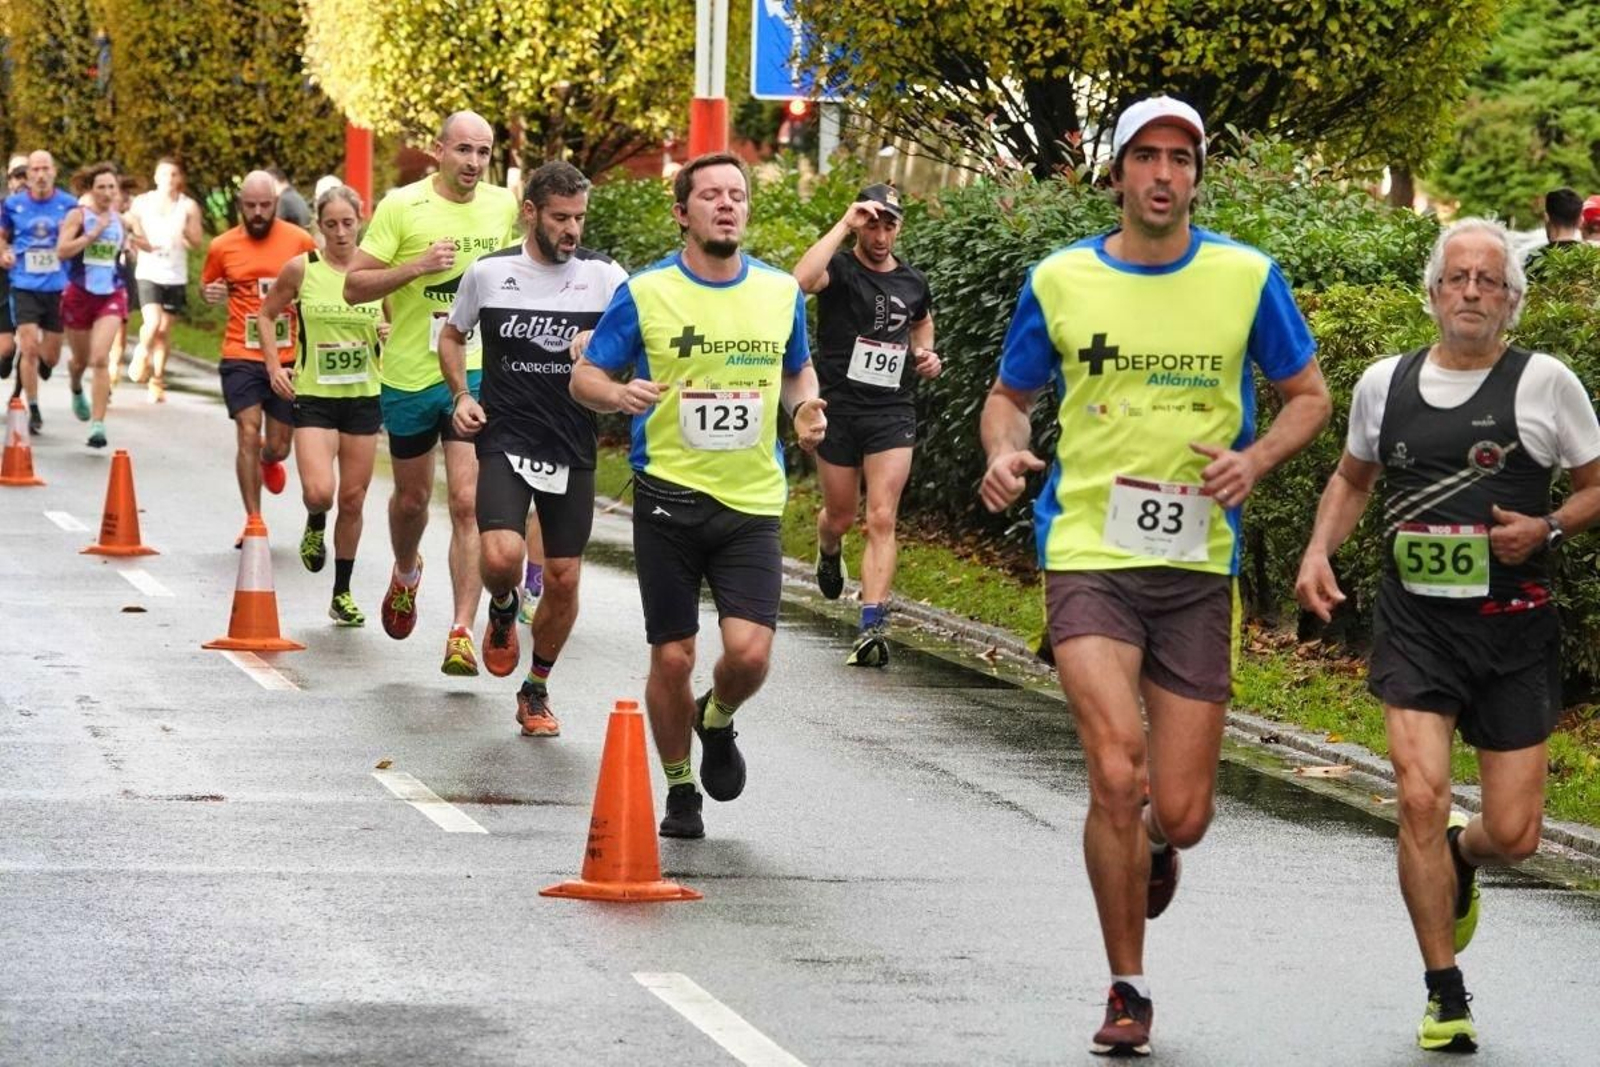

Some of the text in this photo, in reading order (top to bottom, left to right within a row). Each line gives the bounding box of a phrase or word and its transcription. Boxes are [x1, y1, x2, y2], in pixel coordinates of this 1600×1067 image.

[874, 295, 885, 330] STUDIO
[543, 339, 563, 347] fresh
[701, 340, 779, 354] DEPORTE
[326, 350, 361, 369] 595
[511, 360, 575, 374] CABREIRO
[725, 353, 777, 367] Atlántico
[864, 351, 898, 373] 196
[1115, 354, 1223, 371] DEPORTE
[1146, 372, 1219, 388] Atlántico
[695, 404, 749, 431] 123
[1137, 499, 1184, 535] 83
[1407, 541, 1474, 575] 536
